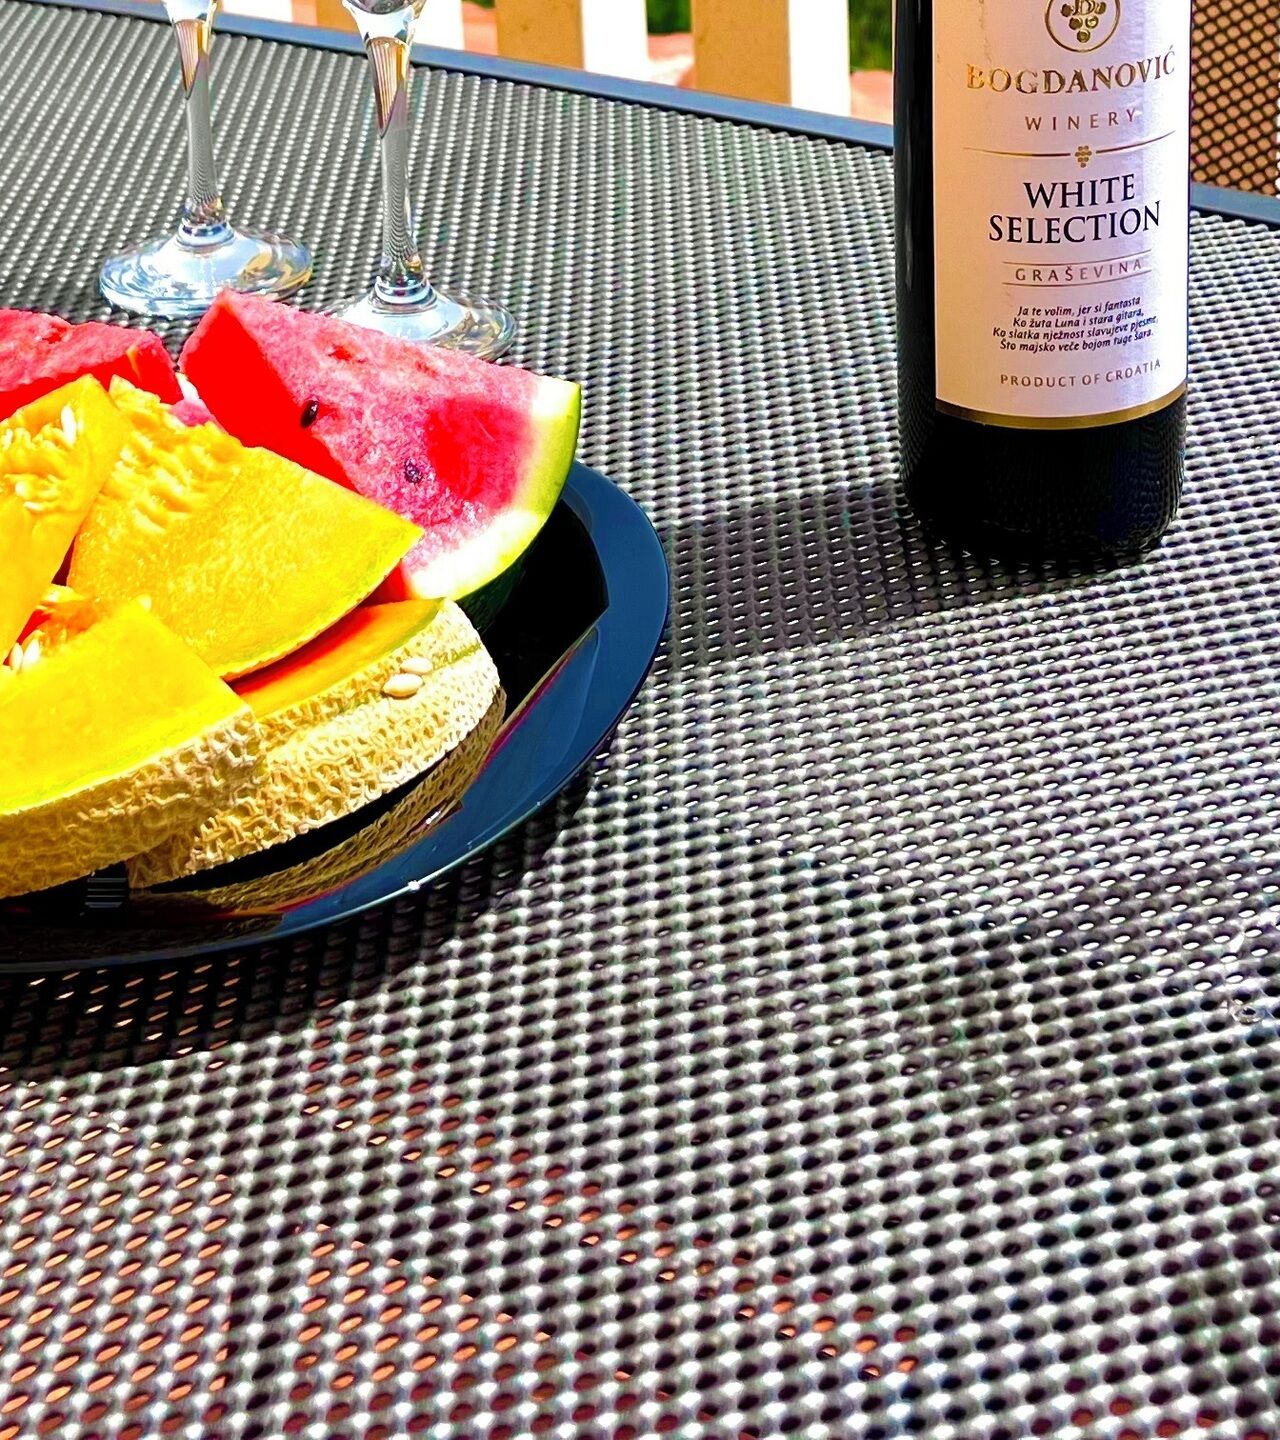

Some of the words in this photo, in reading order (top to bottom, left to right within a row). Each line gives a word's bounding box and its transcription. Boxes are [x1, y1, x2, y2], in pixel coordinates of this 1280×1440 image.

[966, 45, 1175, 94] BOGDANOVIĆ
[1025, 109, 1136, 131] WINERY
[1023, 173, 1135, 209] WHITE
[989, 200, 1160, 244] SELECTION
[1015, 259, 1142, 282] GRAŠEVINA
[1013, 317, 1027, 328] Ko
[1029, 318, 1052, 328] žuta
[1055, 318, 1080, 328] Luna
[1089, 314, 1114, 325] stara
[1116, 308, 1144, 324] gitara,
[1017, 306, 1029, 316] Ja
[1032, 307, 1041, 316] te
[1045, 306, 1075, 317] volim,
[1077, 305, 1092, 317] jer
[1094, 302, 1102, 312] si
[1103, 297, 1141, 314] fantasta
[993, 327, 1006, 337] Ko
[1008, 328, 1040, 340] slatka
[1043, 329, 1085, 342] nježnost
[1087, 323, 1128, 337] slavujeve
[1000, 338, 1016, 350] Što
[1019, 341, 1056, 353] majsko
[1058, 341, 1080, 351] veče
[1082, 339, 1111, 351] bojom
[1114, 334, 1132, 346] tuge
[1000, 374, 1076, 387] PRODUCT
[1082, 373, 1100, 385] OF
[1106, 358, 1161, 382] CROATIA
